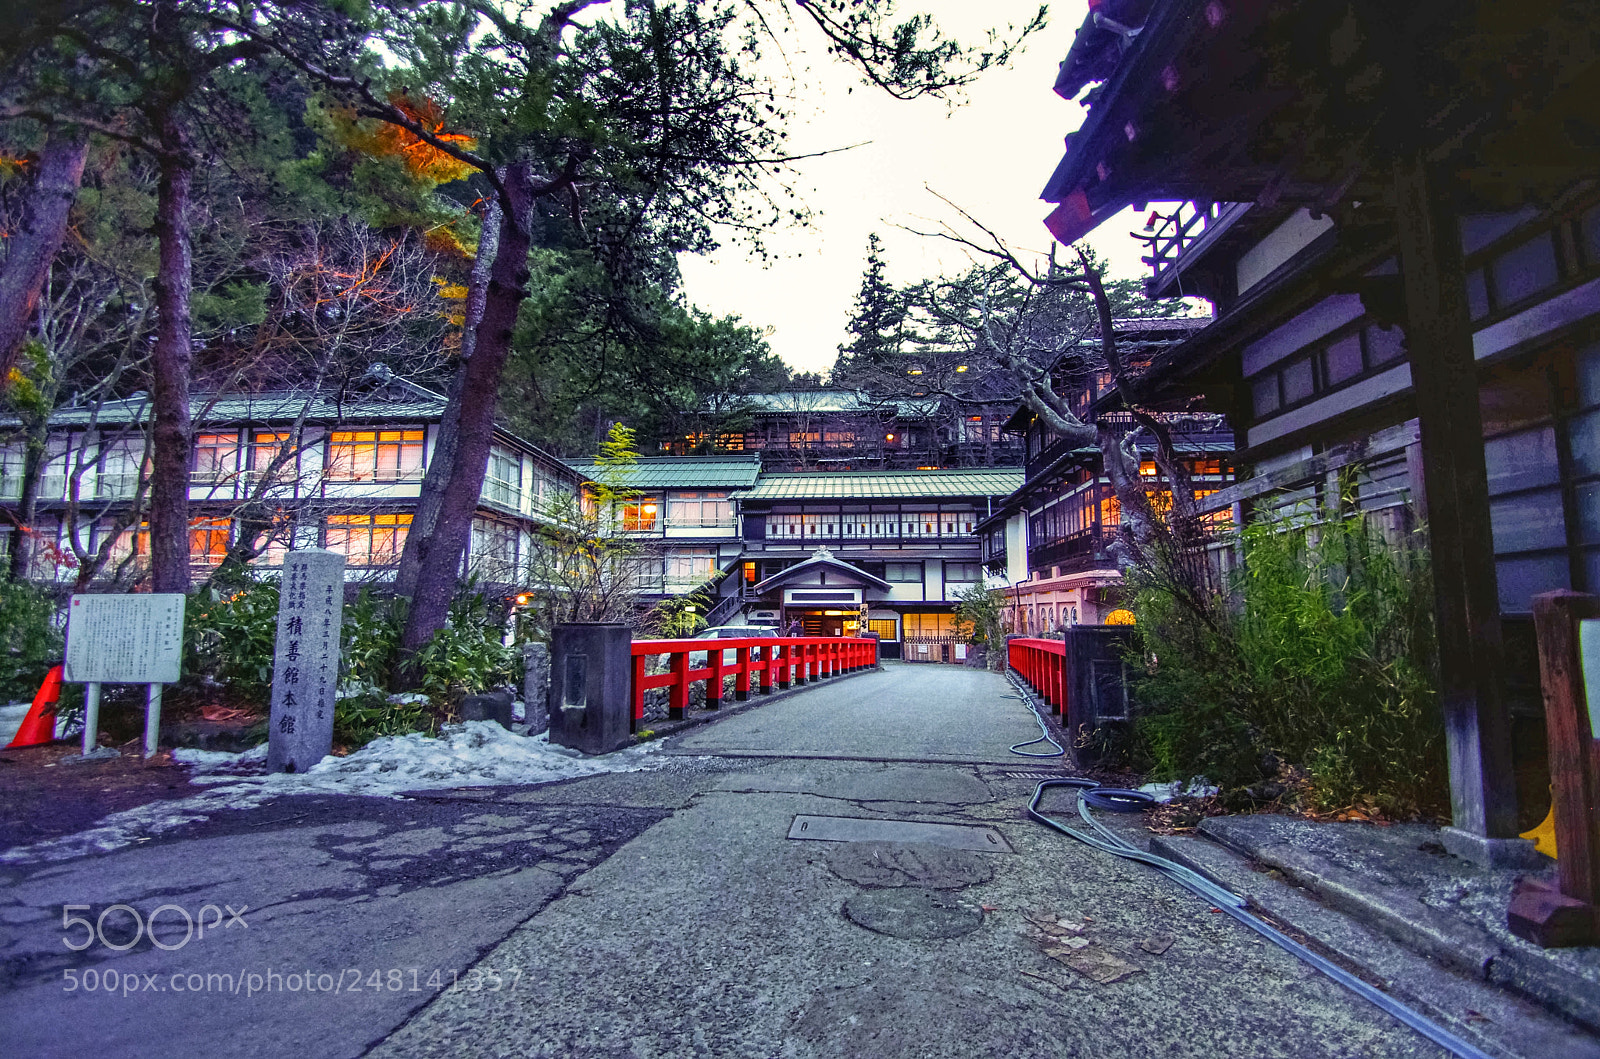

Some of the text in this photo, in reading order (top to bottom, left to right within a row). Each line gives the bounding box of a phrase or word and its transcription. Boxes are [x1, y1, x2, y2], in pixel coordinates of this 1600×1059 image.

[278, 615, 303, 734] 積善館本館
